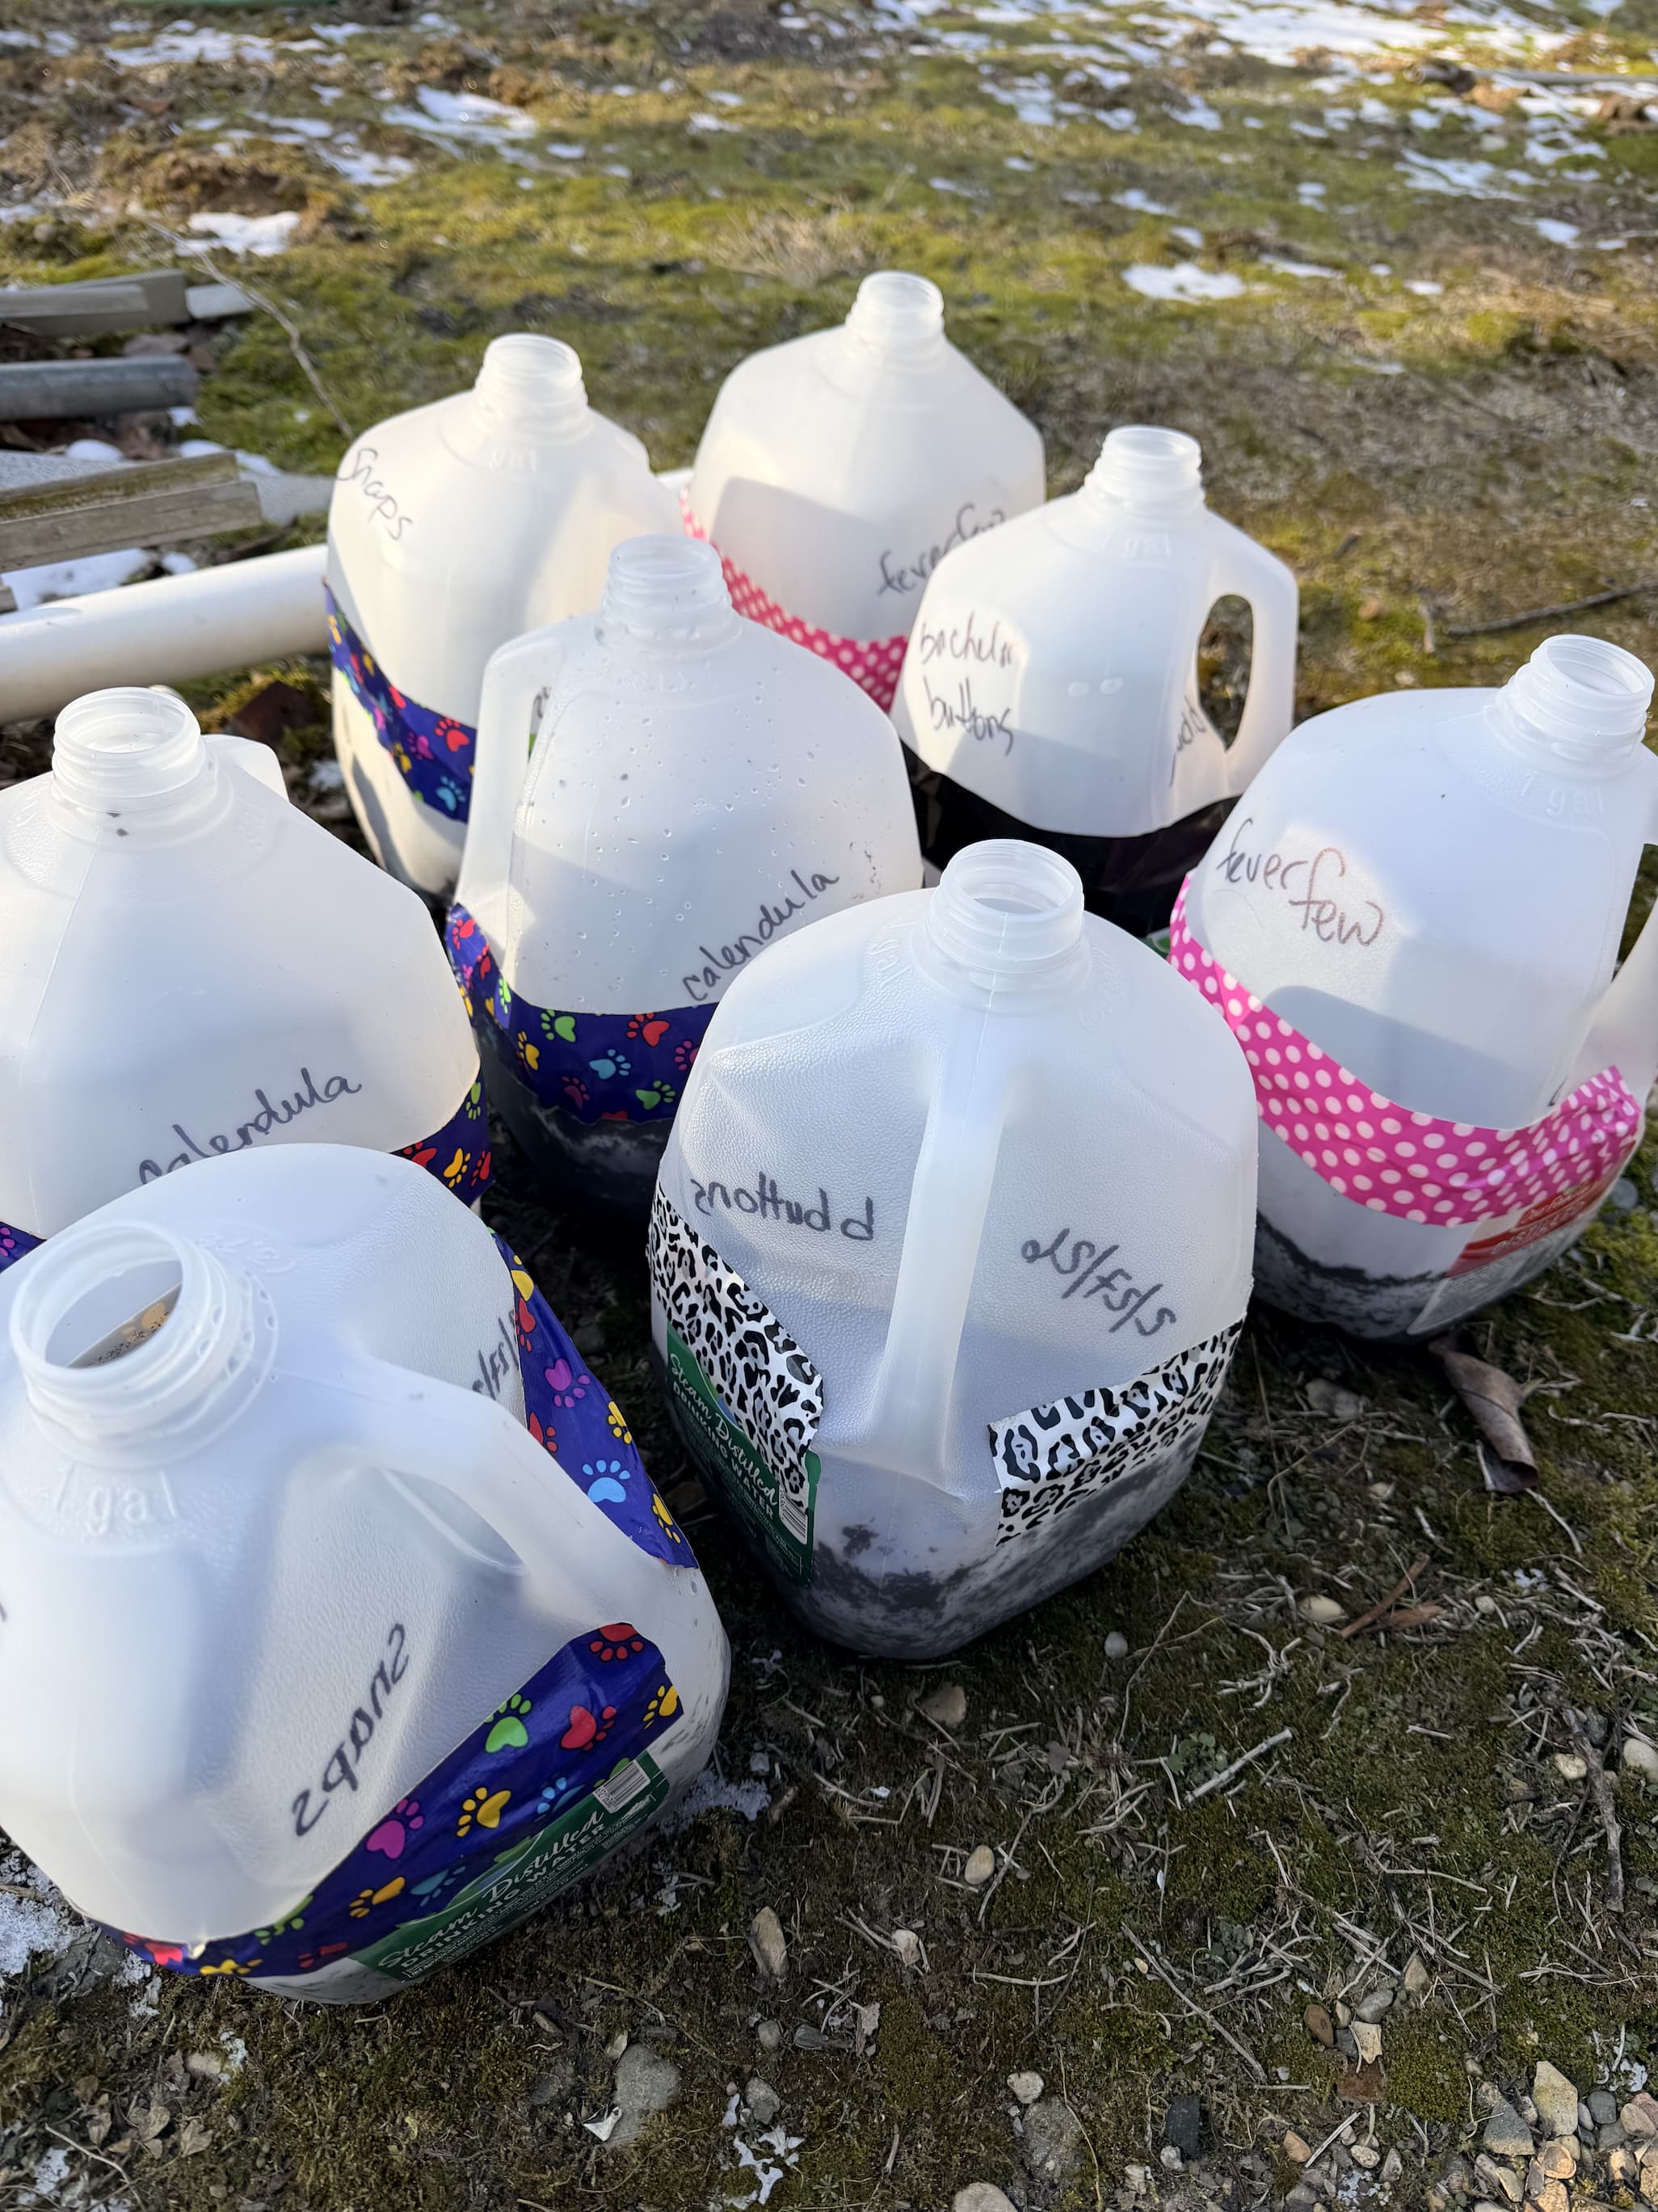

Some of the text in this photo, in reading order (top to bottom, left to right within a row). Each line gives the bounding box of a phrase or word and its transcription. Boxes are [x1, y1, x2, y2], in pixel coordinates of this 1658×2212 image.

[922, 673, 1015, 756] buttons
[1544, 786, 1604, 818] gal
[681, 867, 841, 1002] calendula
[670, 1352, 713, 1420] Steam
[715, 1412, 779, 1506] Distilled
[673, 1382, 728, 1460] DRINKING
[730, 1457, 775, 1521] WATER
[83, 1468, 179, 1536] gal
[378, 1907, 478, 1969] Steam
[481, 1810, 604, 1903] Distilled
[401, 1888, 521, 1969] DRINKING
[525, 1823, 607, 1883] WATER
